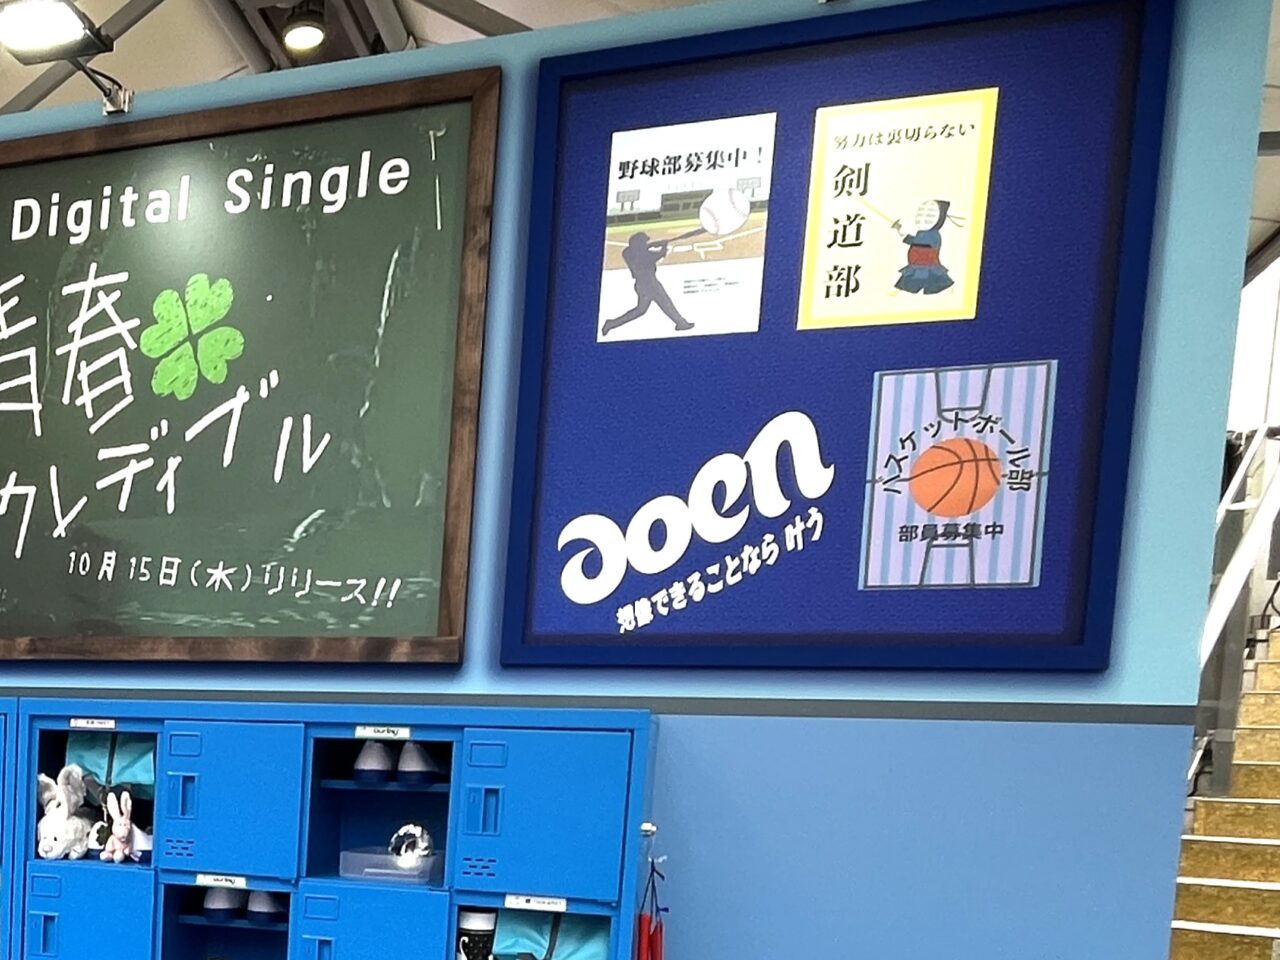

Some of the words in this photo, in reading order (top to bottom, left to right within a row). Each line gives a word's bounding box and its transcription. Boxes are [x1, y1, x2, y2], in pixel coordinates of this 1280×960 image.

[617, 146, 763, 181] 野球部募集中!
[833, 120, 977, 152] 努力は裏切らない
[11, 174, 191, 245] Digital
[224, 150, 412, 214] Single
[822, 161, 872, 300] 剣道部
[877, 411, 1034, 495] バスケットボール部
[898, 521, 1004, 542] 部員募集中
